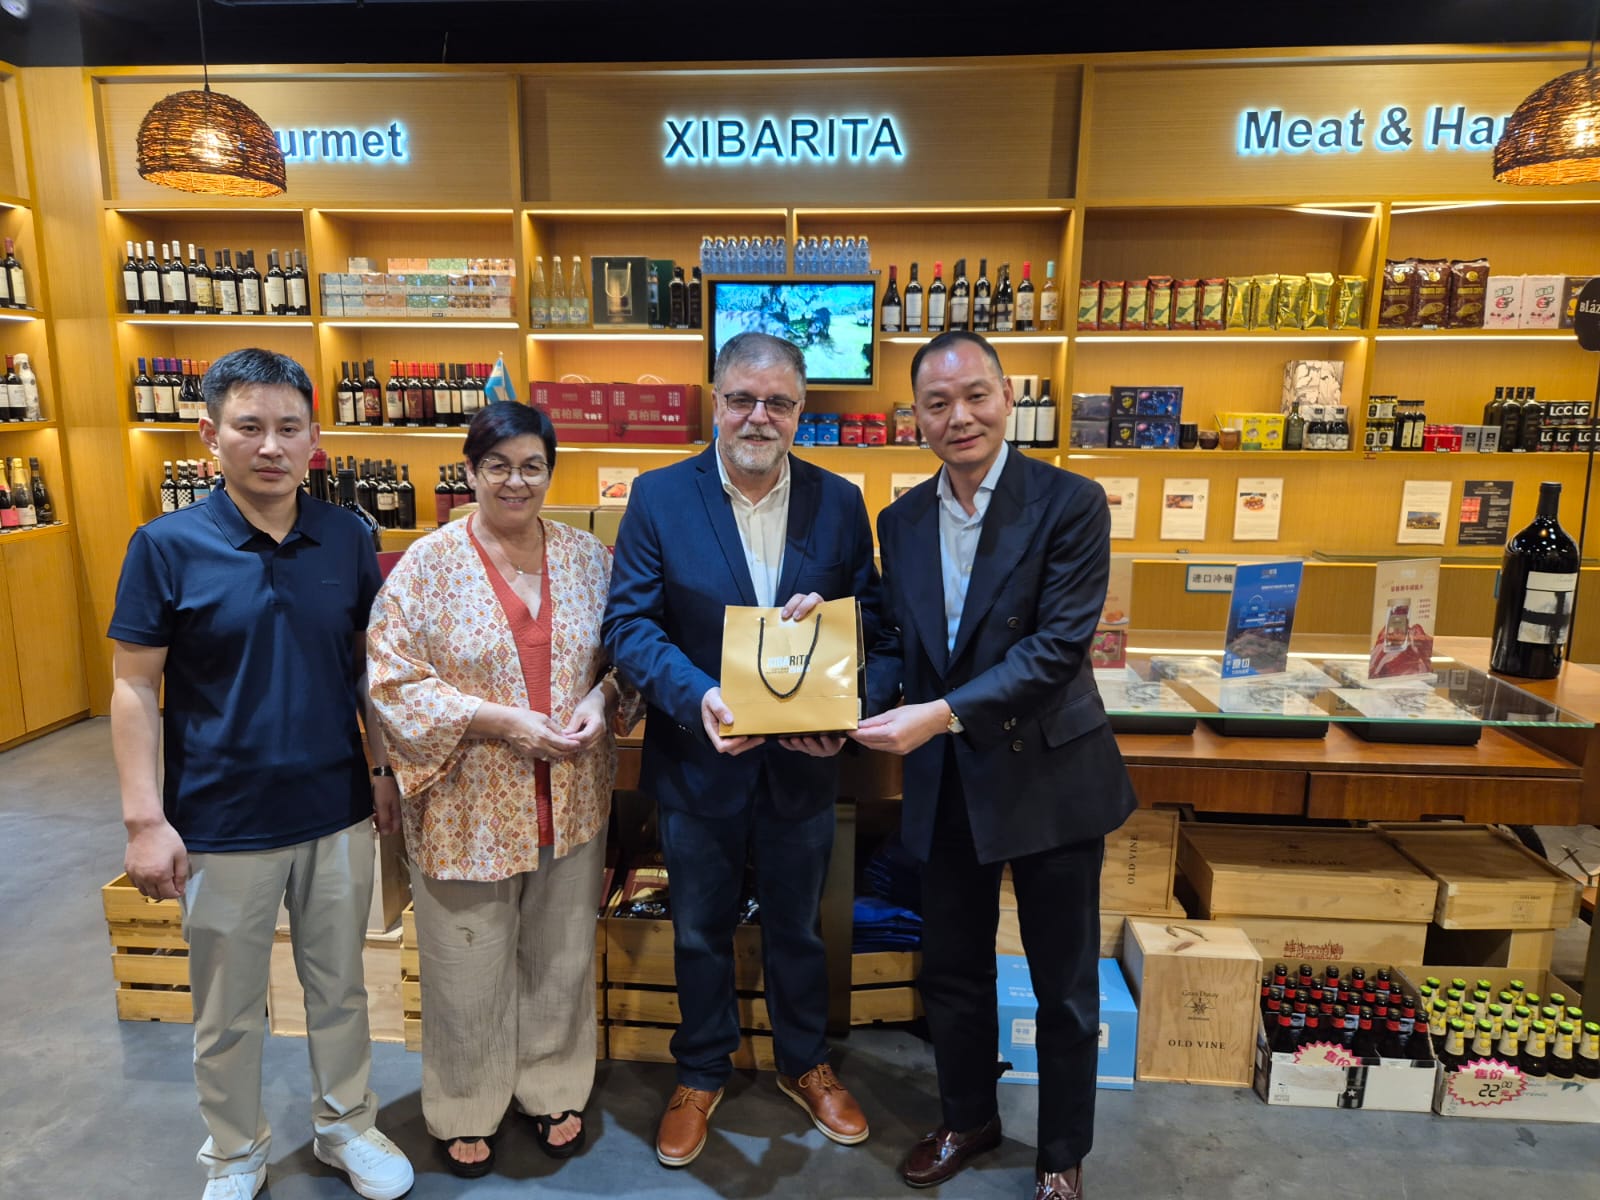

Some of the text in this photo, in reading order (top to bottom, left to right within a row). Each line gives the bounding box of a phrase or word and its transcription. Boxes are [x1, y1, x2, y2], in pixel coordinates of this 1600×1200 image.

[1243, 106, 1512, 149] Meat & Ha
[274, 122, 403, 157] urmet
[664, 117, 904, 158] XIBARITA
[1557, 431, 1571, 442] LC
[1577, 431, 1591, 442] LC
[1127, 863, 1136, 885] OLD
[1168, 1039, 1226, 1050] OLD VINE
[1474, 1068, 1505, 1080] 售价
